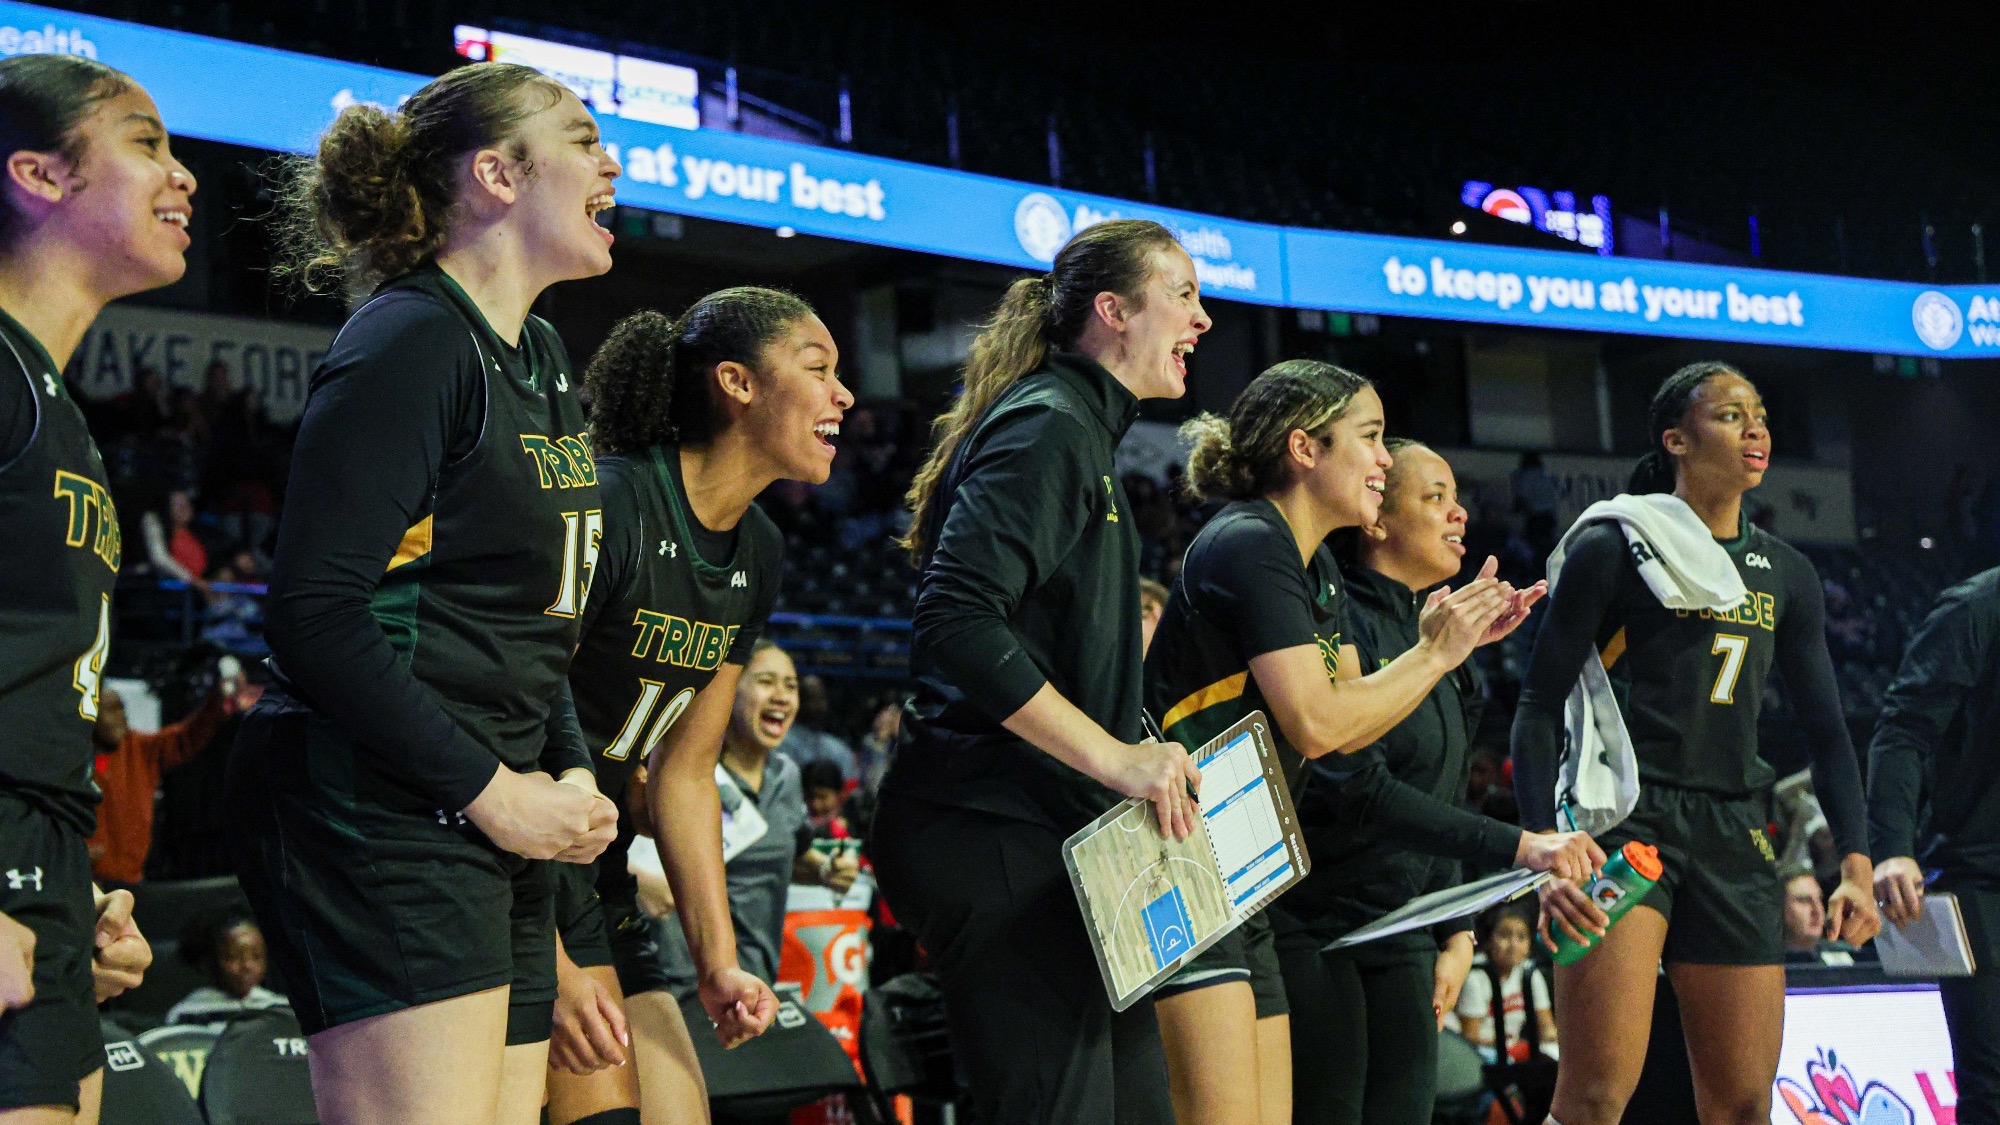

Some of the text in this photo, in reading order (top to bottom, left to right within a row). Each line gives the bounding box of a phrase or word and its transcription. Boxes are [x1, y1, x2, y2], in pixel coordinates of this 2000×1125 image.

[627, 143, 678, 187] at
[681, 155, 786, 203] your
[789, 162, 886, 221] best
[1383, 256, 1804, 327] to keep you at your best
[520, 432, 599, 489] TRB
[544, 509, 603, 619] 15
[1745, 553, 1772, 569] CAA
[1710, 633, 1748, 704] 7
[603, 678, 695, 761] 10
[1289, 832, 1307, 877] Basketball
